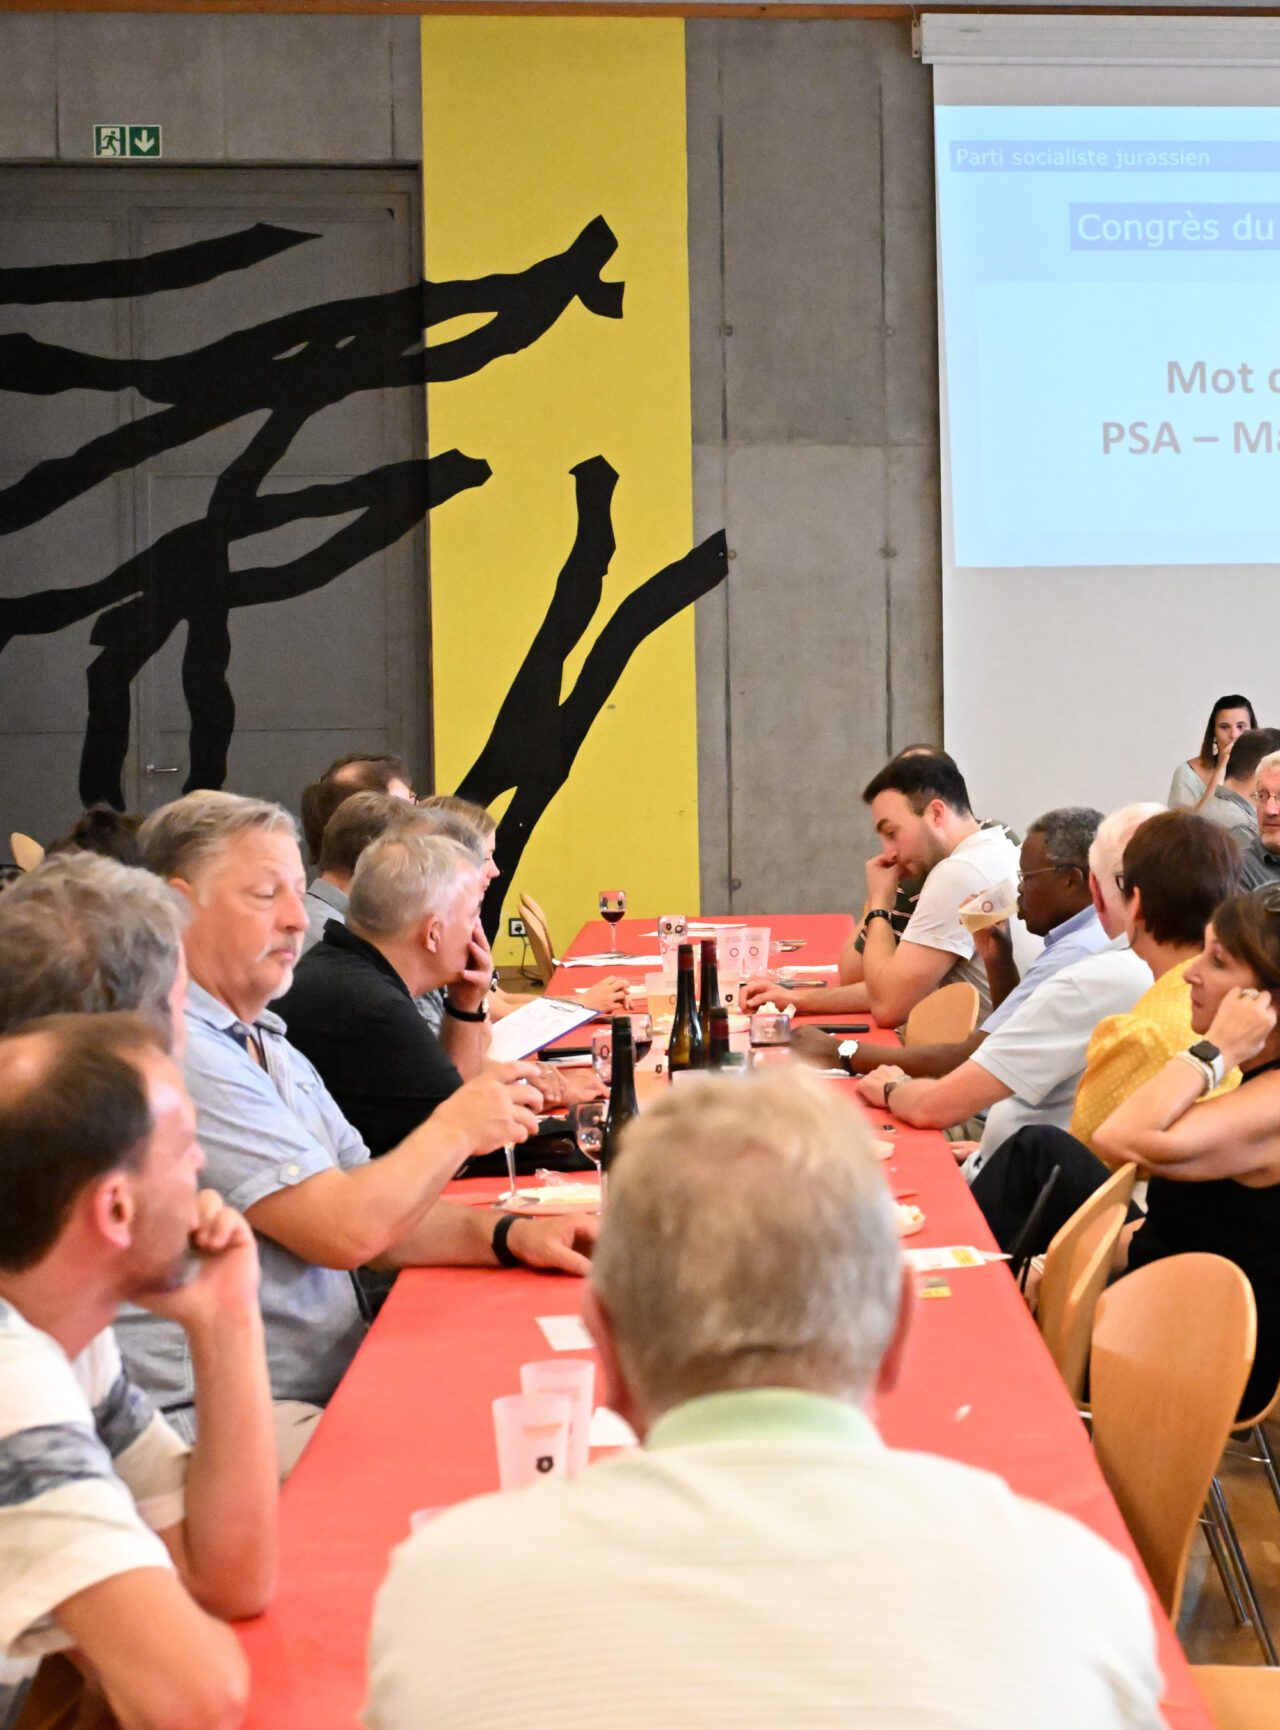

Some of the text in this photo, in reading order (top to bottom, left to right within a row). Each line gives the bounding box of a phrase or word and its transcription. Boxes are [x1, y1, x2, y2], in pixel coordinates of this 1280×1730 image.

[955, 148, 1211, 170] Parti socialiste jurassien
[1077, 210, 1219, 247] Congrès
[1232, 211, 1274, 241] du
[1166, 360, 1255, 395] Mot
[1102, 420, 1182, 456] PSA
